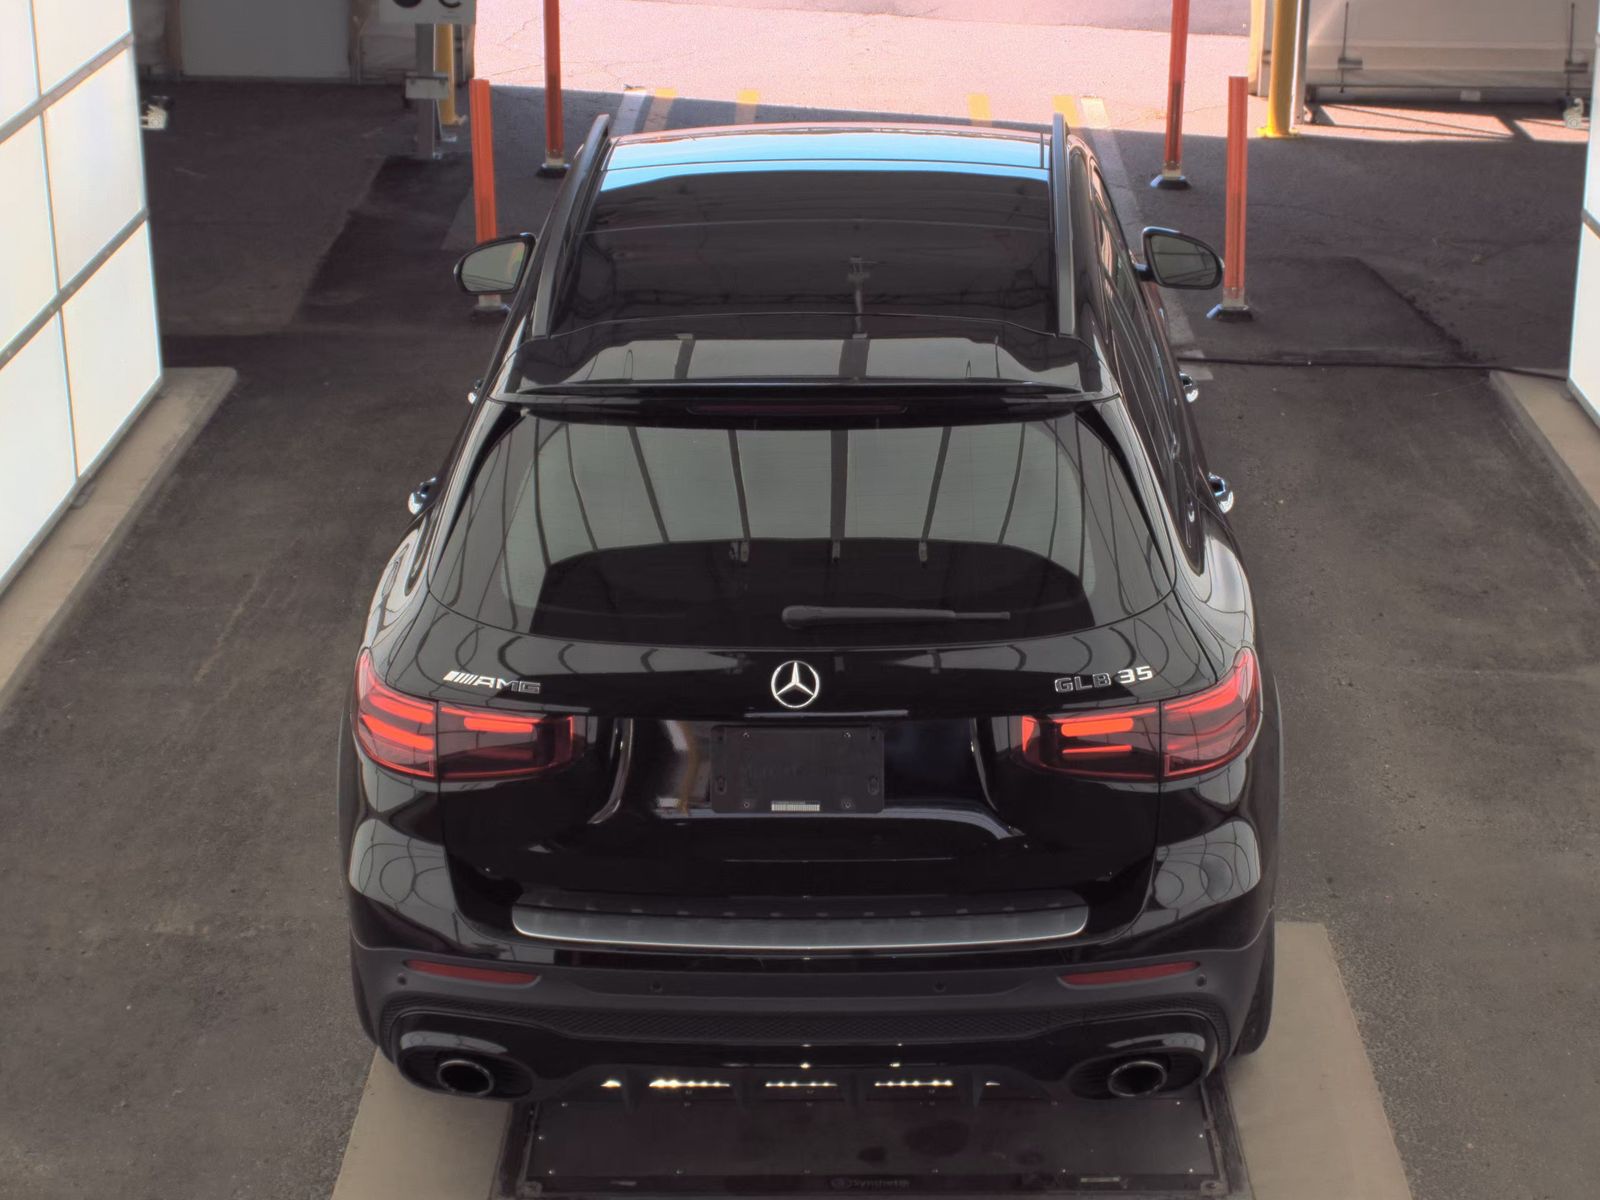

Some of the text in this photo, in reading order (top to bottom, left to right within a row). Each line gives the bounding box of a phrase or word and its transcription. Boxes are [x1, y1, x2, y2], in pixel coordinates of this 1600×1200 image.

[471, 675, 541, 694] AMG
[1054, 665, 1153, 693] GLB 35
